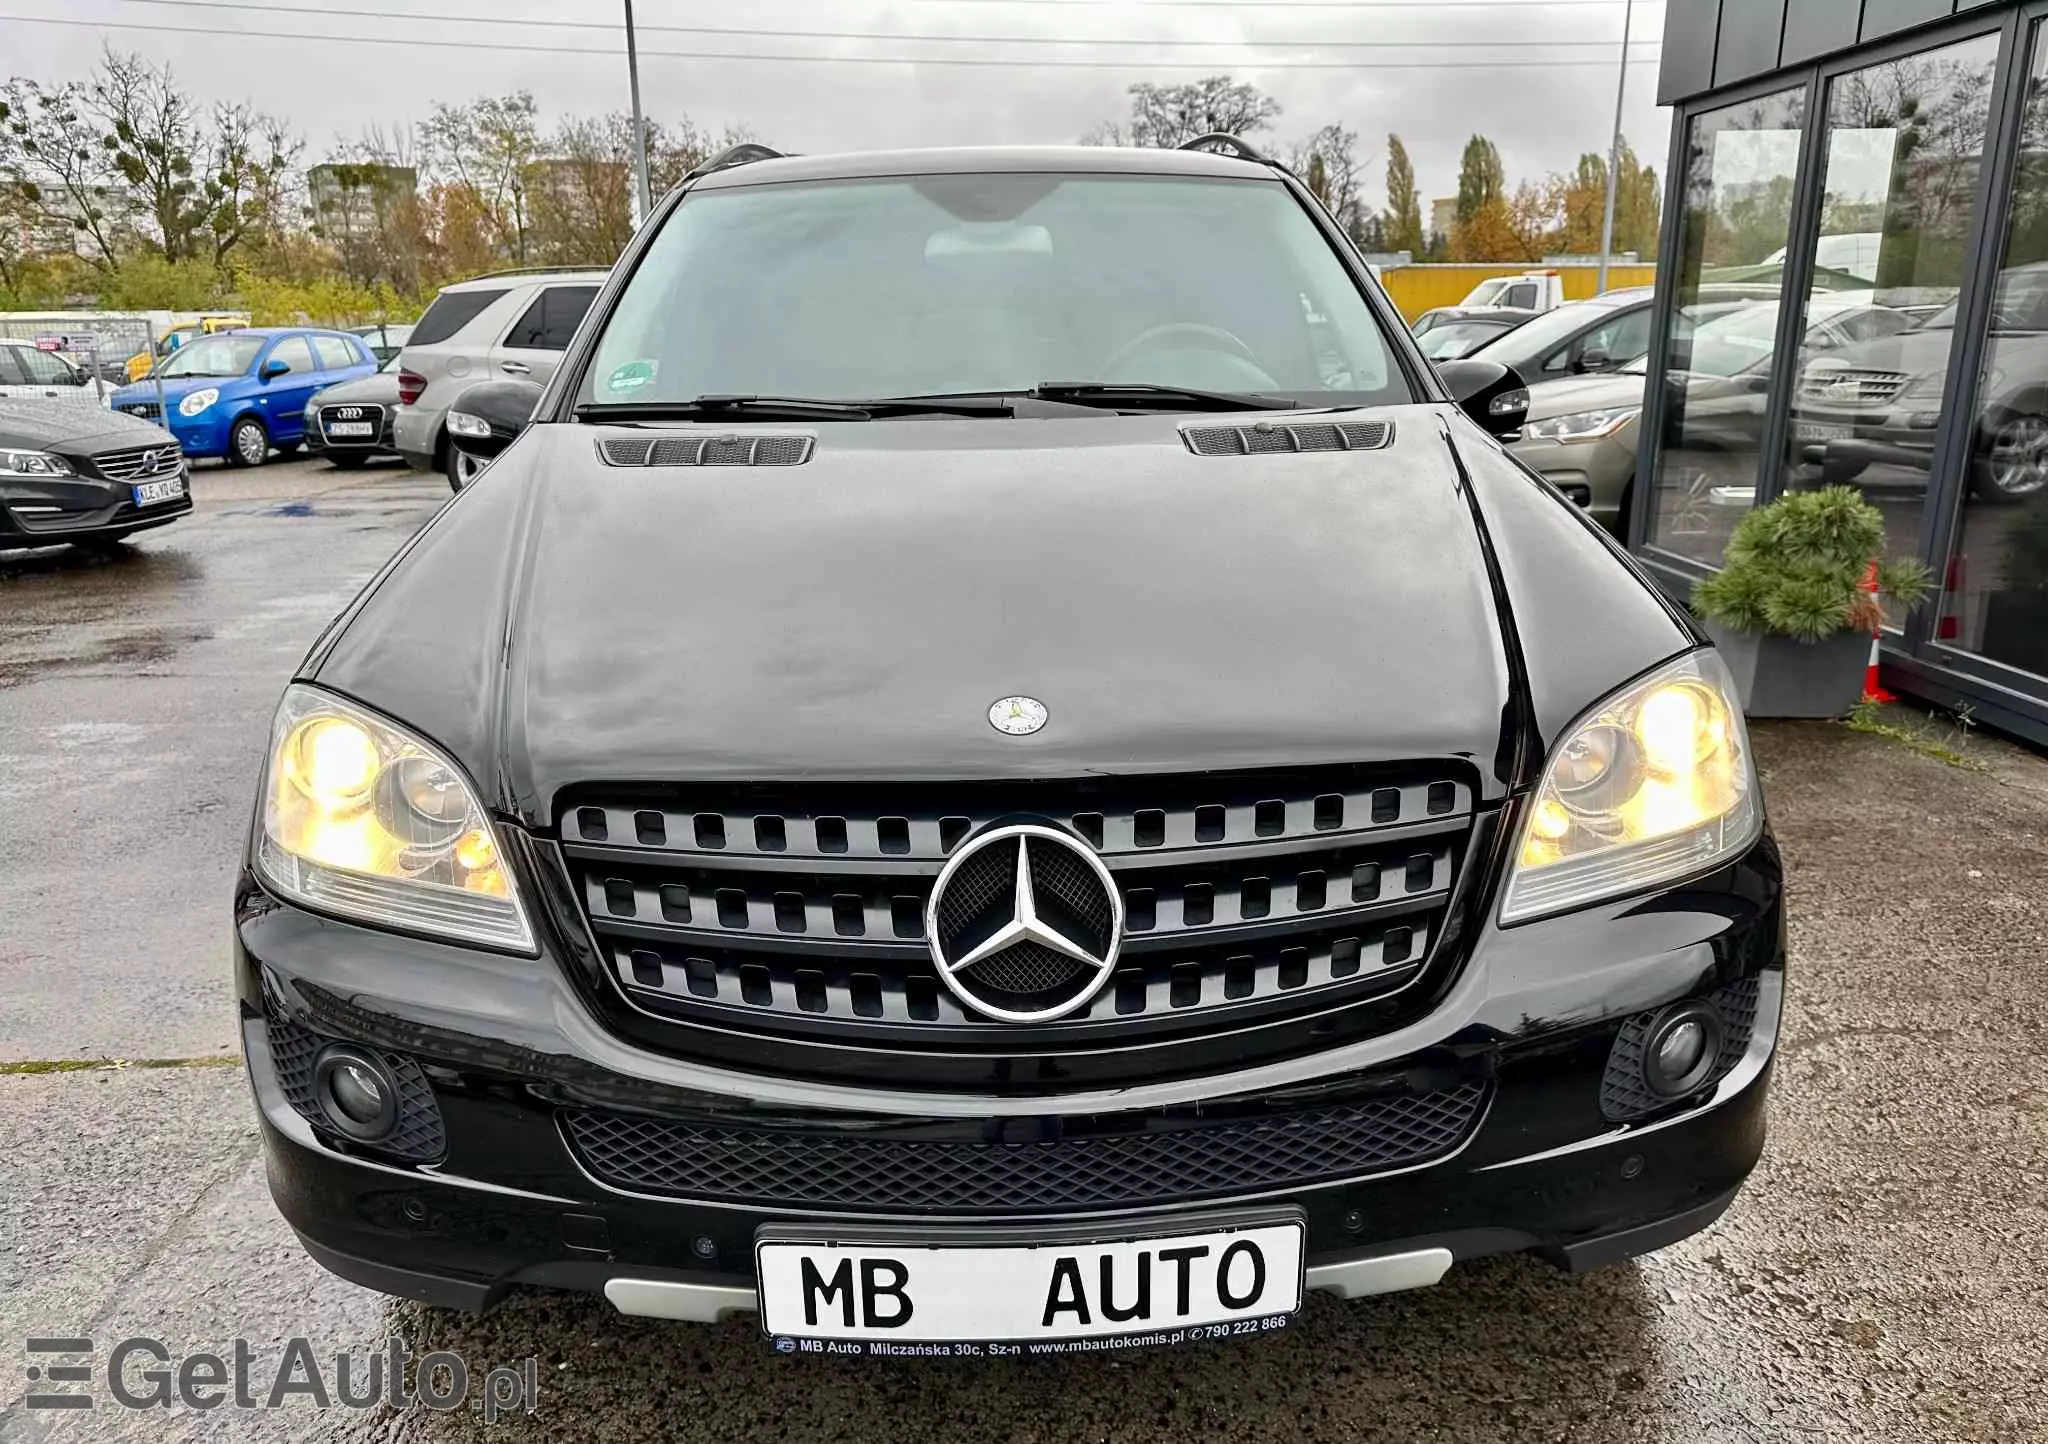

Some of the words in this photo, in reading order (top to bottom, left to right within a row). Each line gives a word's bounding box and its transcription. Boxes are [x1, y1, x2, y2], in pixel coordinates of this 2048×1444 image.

[140, 484, 155, 502] KLE
[800, 1256, 914, 1328] MB
[1042, 1239, 1266, 1326] AUTO
[800, 1339, 823, 1353] MB
[826, 1341, 862, 1355] Auto
[869, 1342, 950, 1356] Milczańska
[954, 1343, 984, 1357] 30c,
[988, 1343, 1021, 1355] Sz-n
[1029, 1329, 1185, 1354] www.mbautokomis.pl
[1205, 1325, 1230, 1338] 790
[1233, 1320, 1258, 1335] 222
[1261, 1315, 1287, 1330] 866
